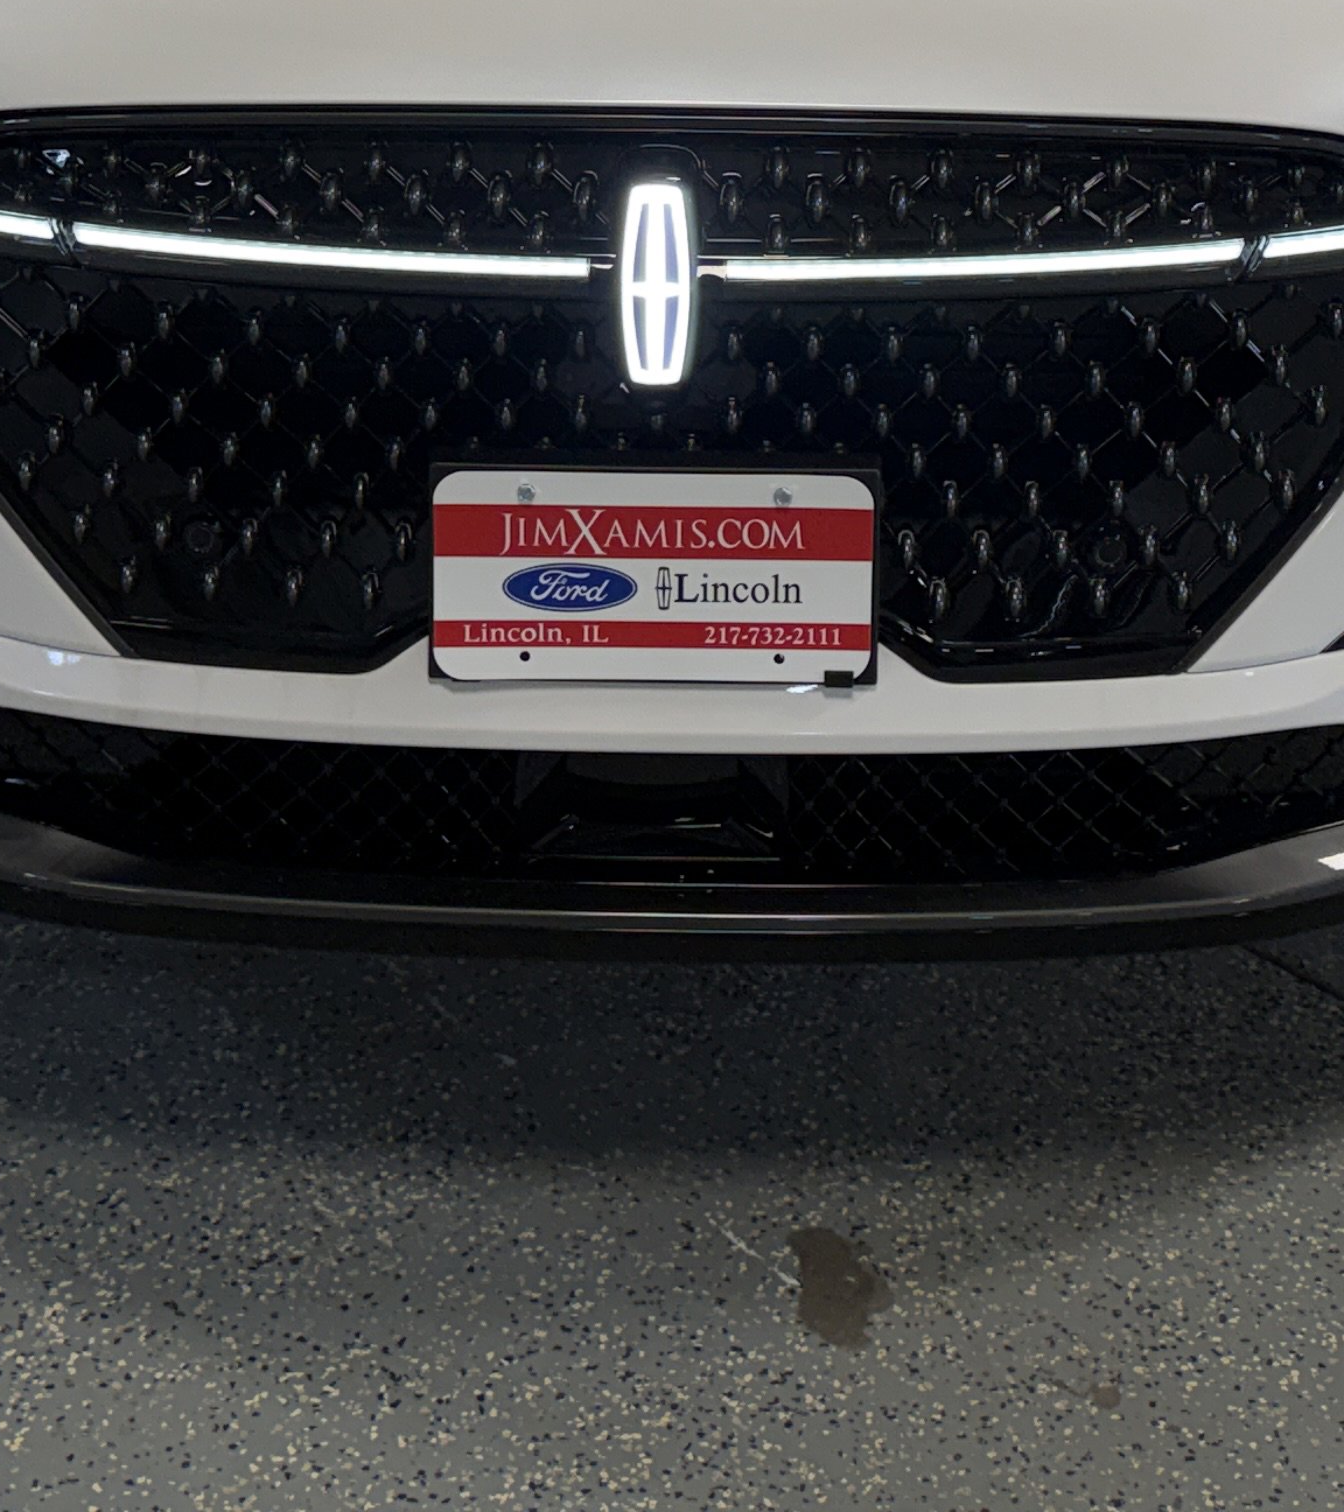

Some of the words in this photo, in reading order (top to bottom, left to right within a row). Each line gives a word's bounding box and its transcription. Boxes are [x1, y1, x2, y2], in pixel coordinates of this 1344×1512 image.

[530, 570, 610, 604] Ford
[674, 573, 803, 605] Lincoln
[463, 623, 571, 645] Lincoln,
[582, 625, 609, 644] IL
[704, 626, 841, 646] 217-732-2111
